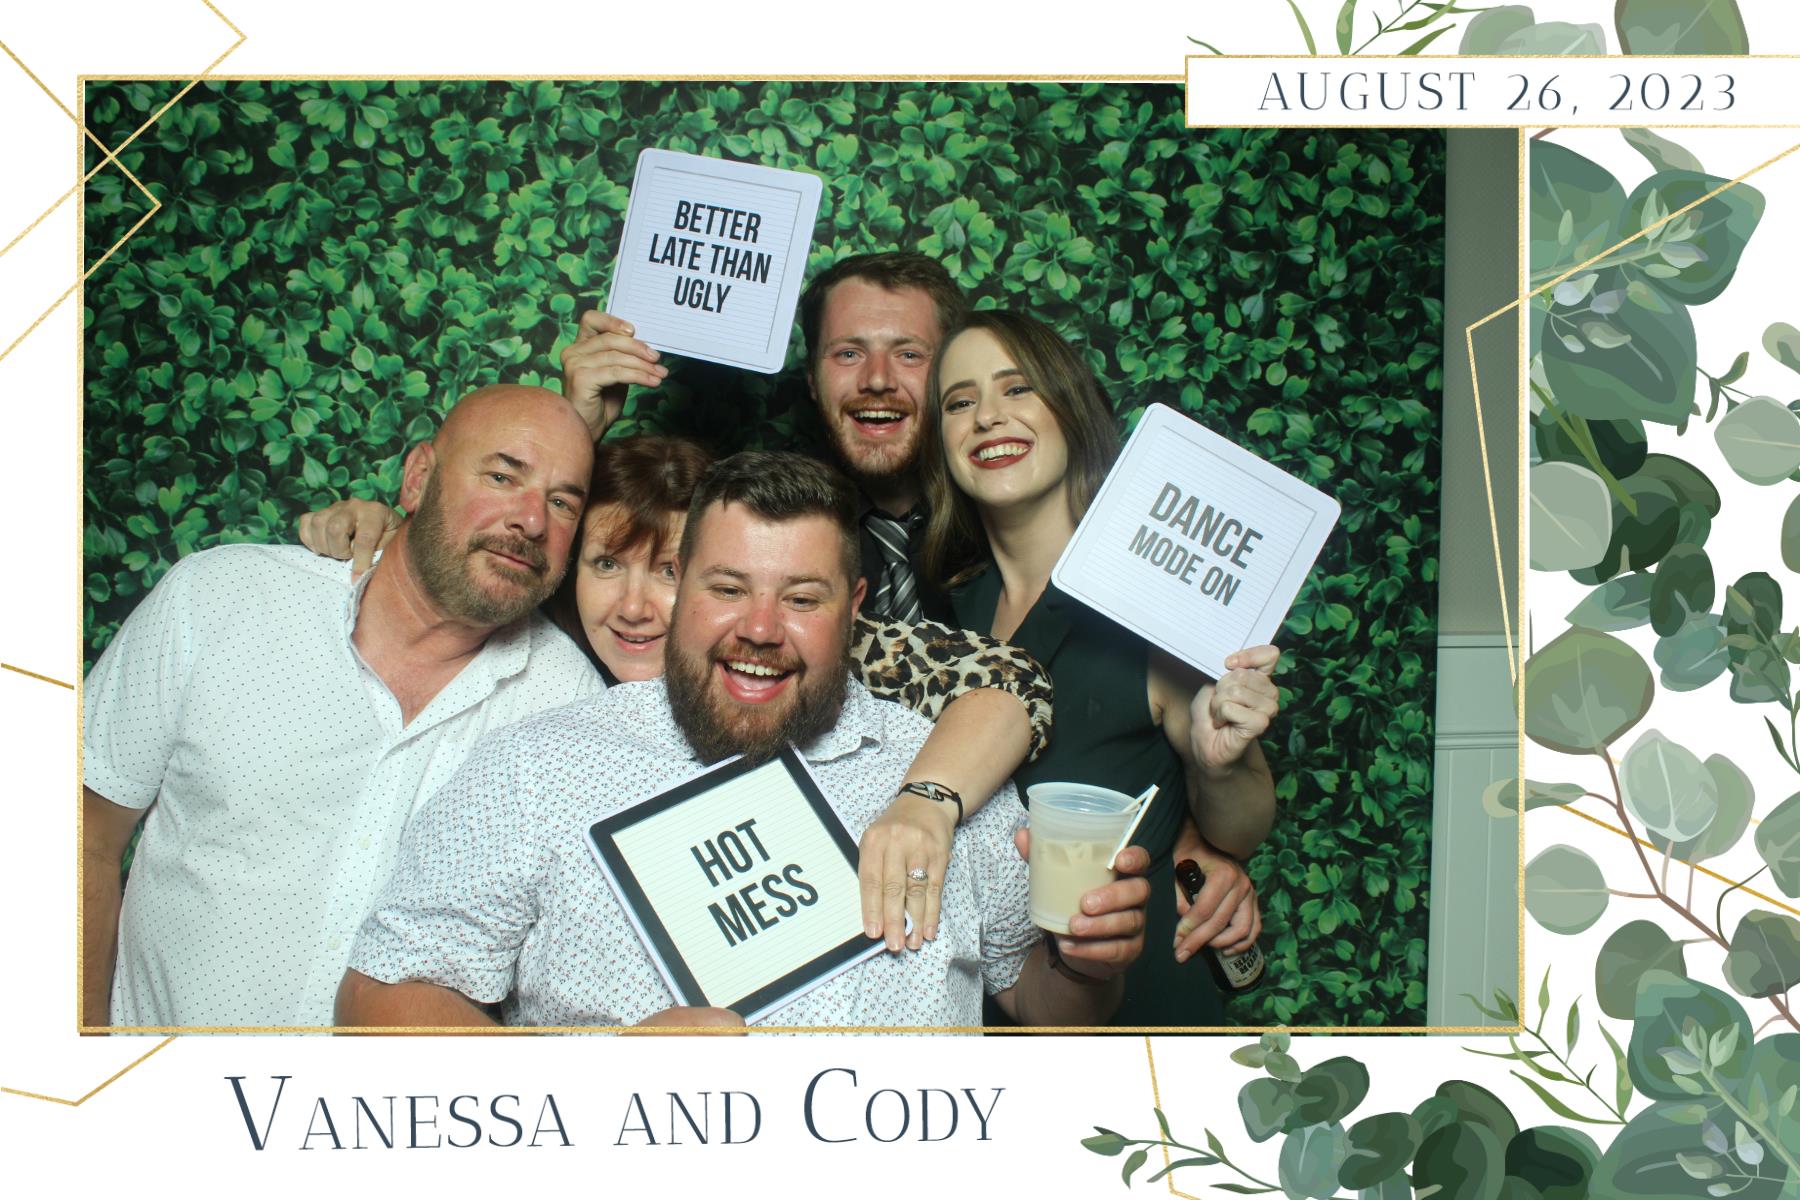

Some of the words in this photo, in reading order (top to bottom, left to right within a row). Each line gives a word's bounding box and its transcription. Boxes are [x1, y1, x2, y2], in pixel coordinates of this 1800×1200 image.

[674, 200, 762, 244] BETTER
[648, 233, 705, 271] LATE
[710, 243, 772, 284] THAN
[673, 275, 732, 314] UGLY
[1148, 481, 1264, 570] DANCE
[1128, 524, 1205, 586] MODE
[1199, 565, 1242, 607] ON
[690, 818, 771, 888] HOT
[707, 863, 819, 947] MESS
